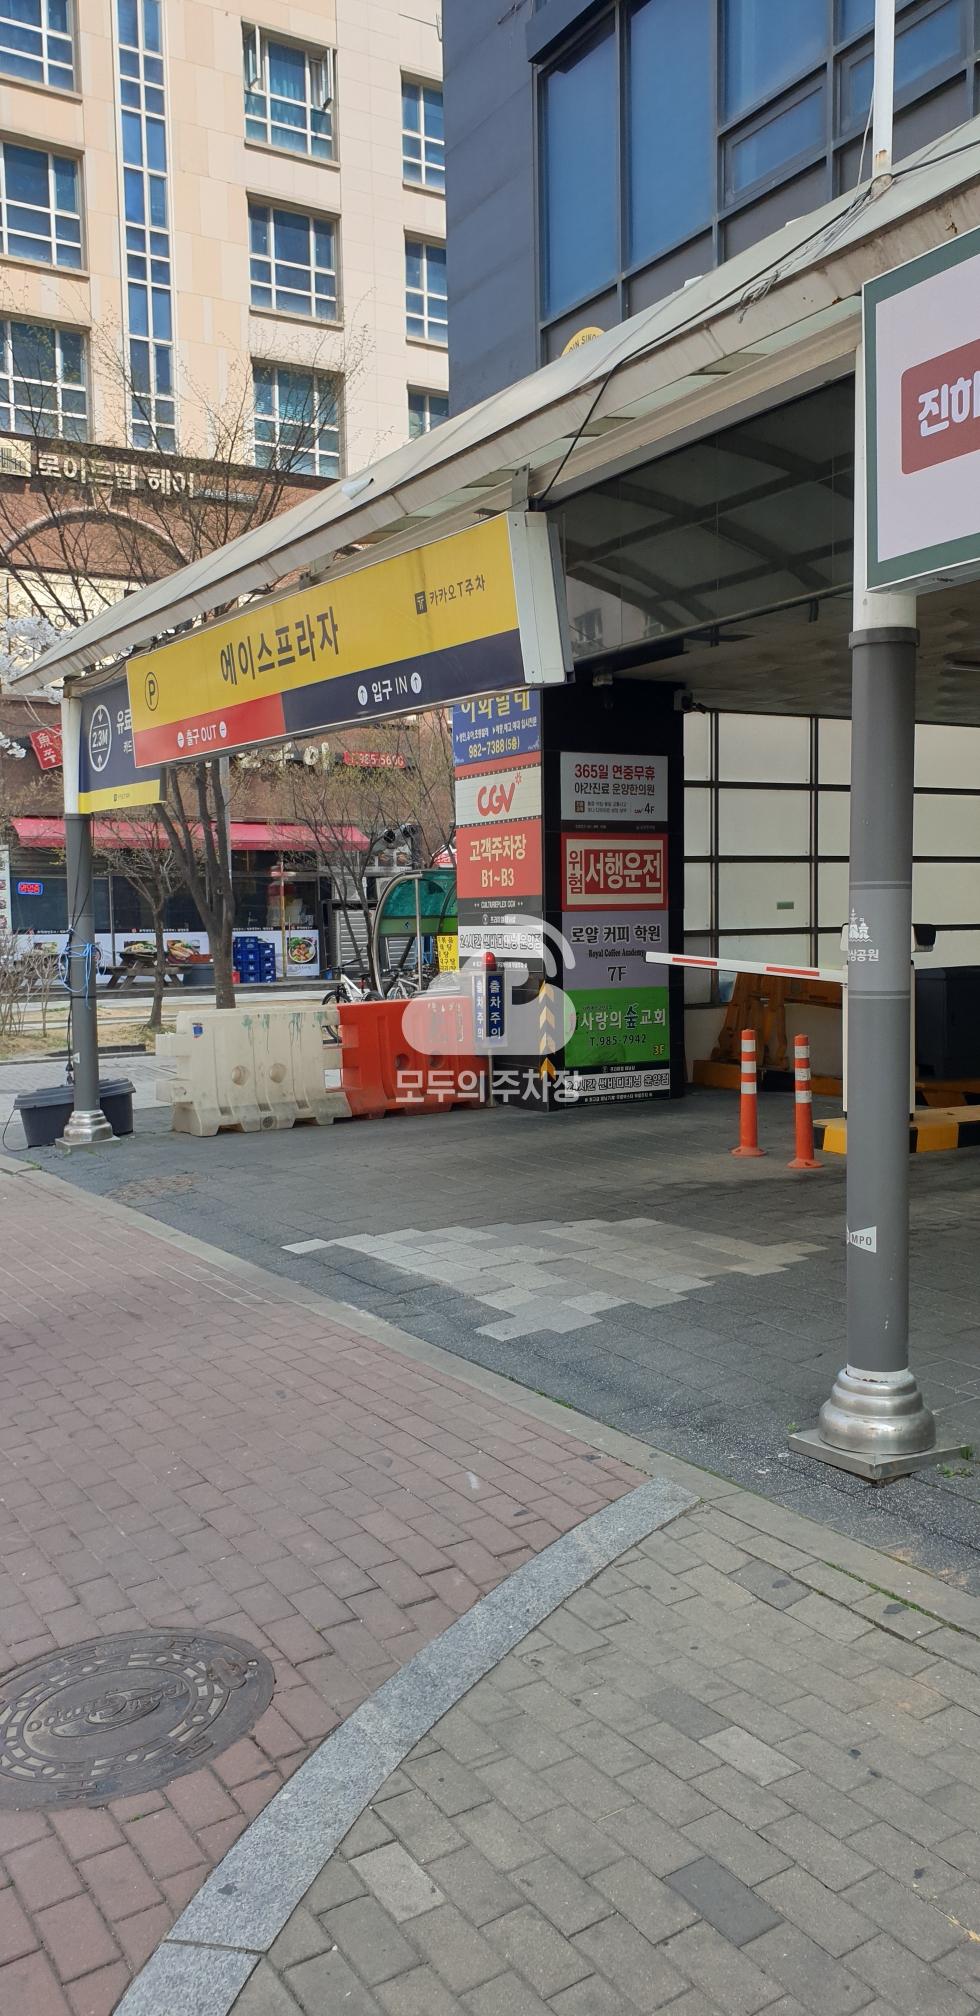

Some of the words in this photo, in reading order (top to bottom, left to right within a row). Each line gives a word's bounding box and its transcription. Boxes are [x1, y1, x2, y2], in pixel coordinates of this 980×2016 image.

[220, 606, 340, 685] 에이스프라자
[371, 679, 393, 703] 입구
[395, 675, 408, 695] IN
[92, 729, 108, 749] 2.3M
[185, 727, 200, 747] 출구
[200, 724, 217, 742] OUT
[574, 763, 610, 780] 365일
[612, 764, 656, 780] 연중무휴
[477, 782, 516, 817] CGV
[574, 782, 611, 796] 야간진료
[612, 783, 656, 797] 운양한의원
[644, 803, 656, 814] 4F
[469, 834, 527, 863] 고객주차장
[481, 868, 514, 888] B1~B3
[568, 850, 583, 894] 위험
[585, 851, 662, 889] 서행운전
[460, 934, 483, 951] 24시간
[571, 926, 600, 945] 로얄
[603, 925, 631, 944] 커피
[634, 924, 662, 943] 학원
[588, 950, 603, 959] Royal
[847, 949, 880, 961] 상공원
[607, 966, 627, 982] 7F
[489, 980, 502, 1040] 출차주의
[652, 1045, 665, 1055] 3F
